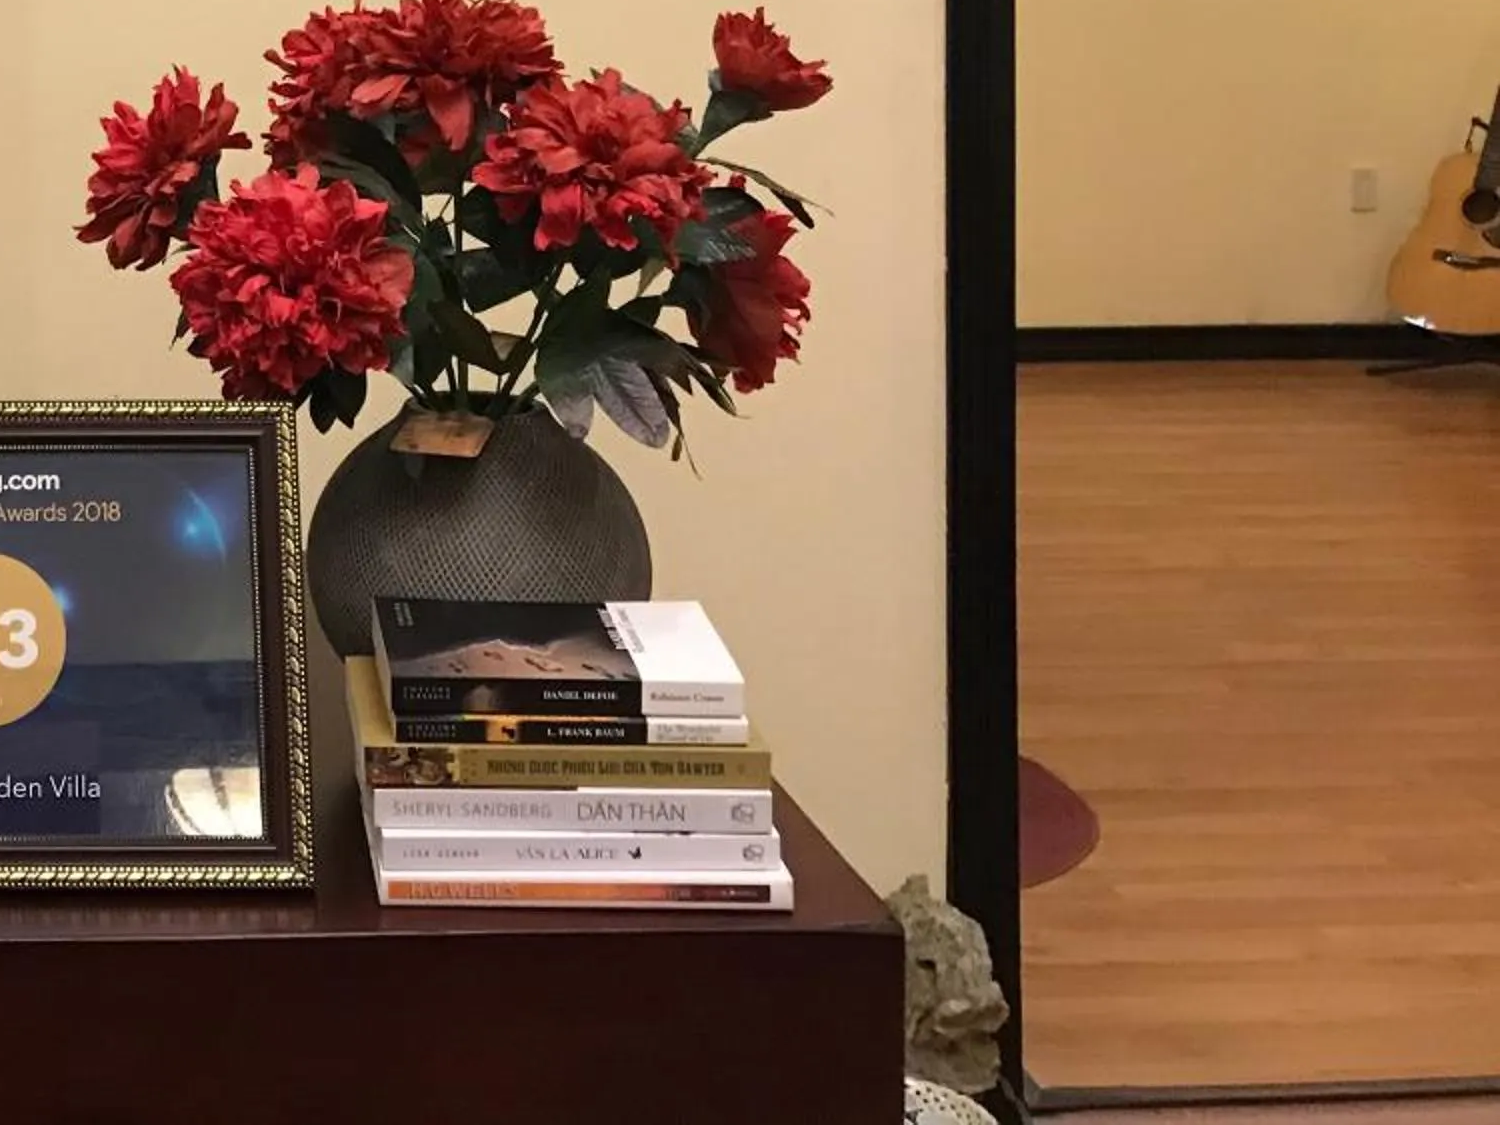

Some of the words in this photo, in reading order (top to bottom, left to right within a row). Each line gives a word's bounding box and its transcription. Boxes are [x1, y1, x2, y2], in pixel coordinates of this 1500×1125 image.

[72, 500, 122, 522] 2018
[49, 774, 102, 798] Villa
[393, 802, 452, 818] SHERYL
[460, 802, 553, 818] SANDBERG
